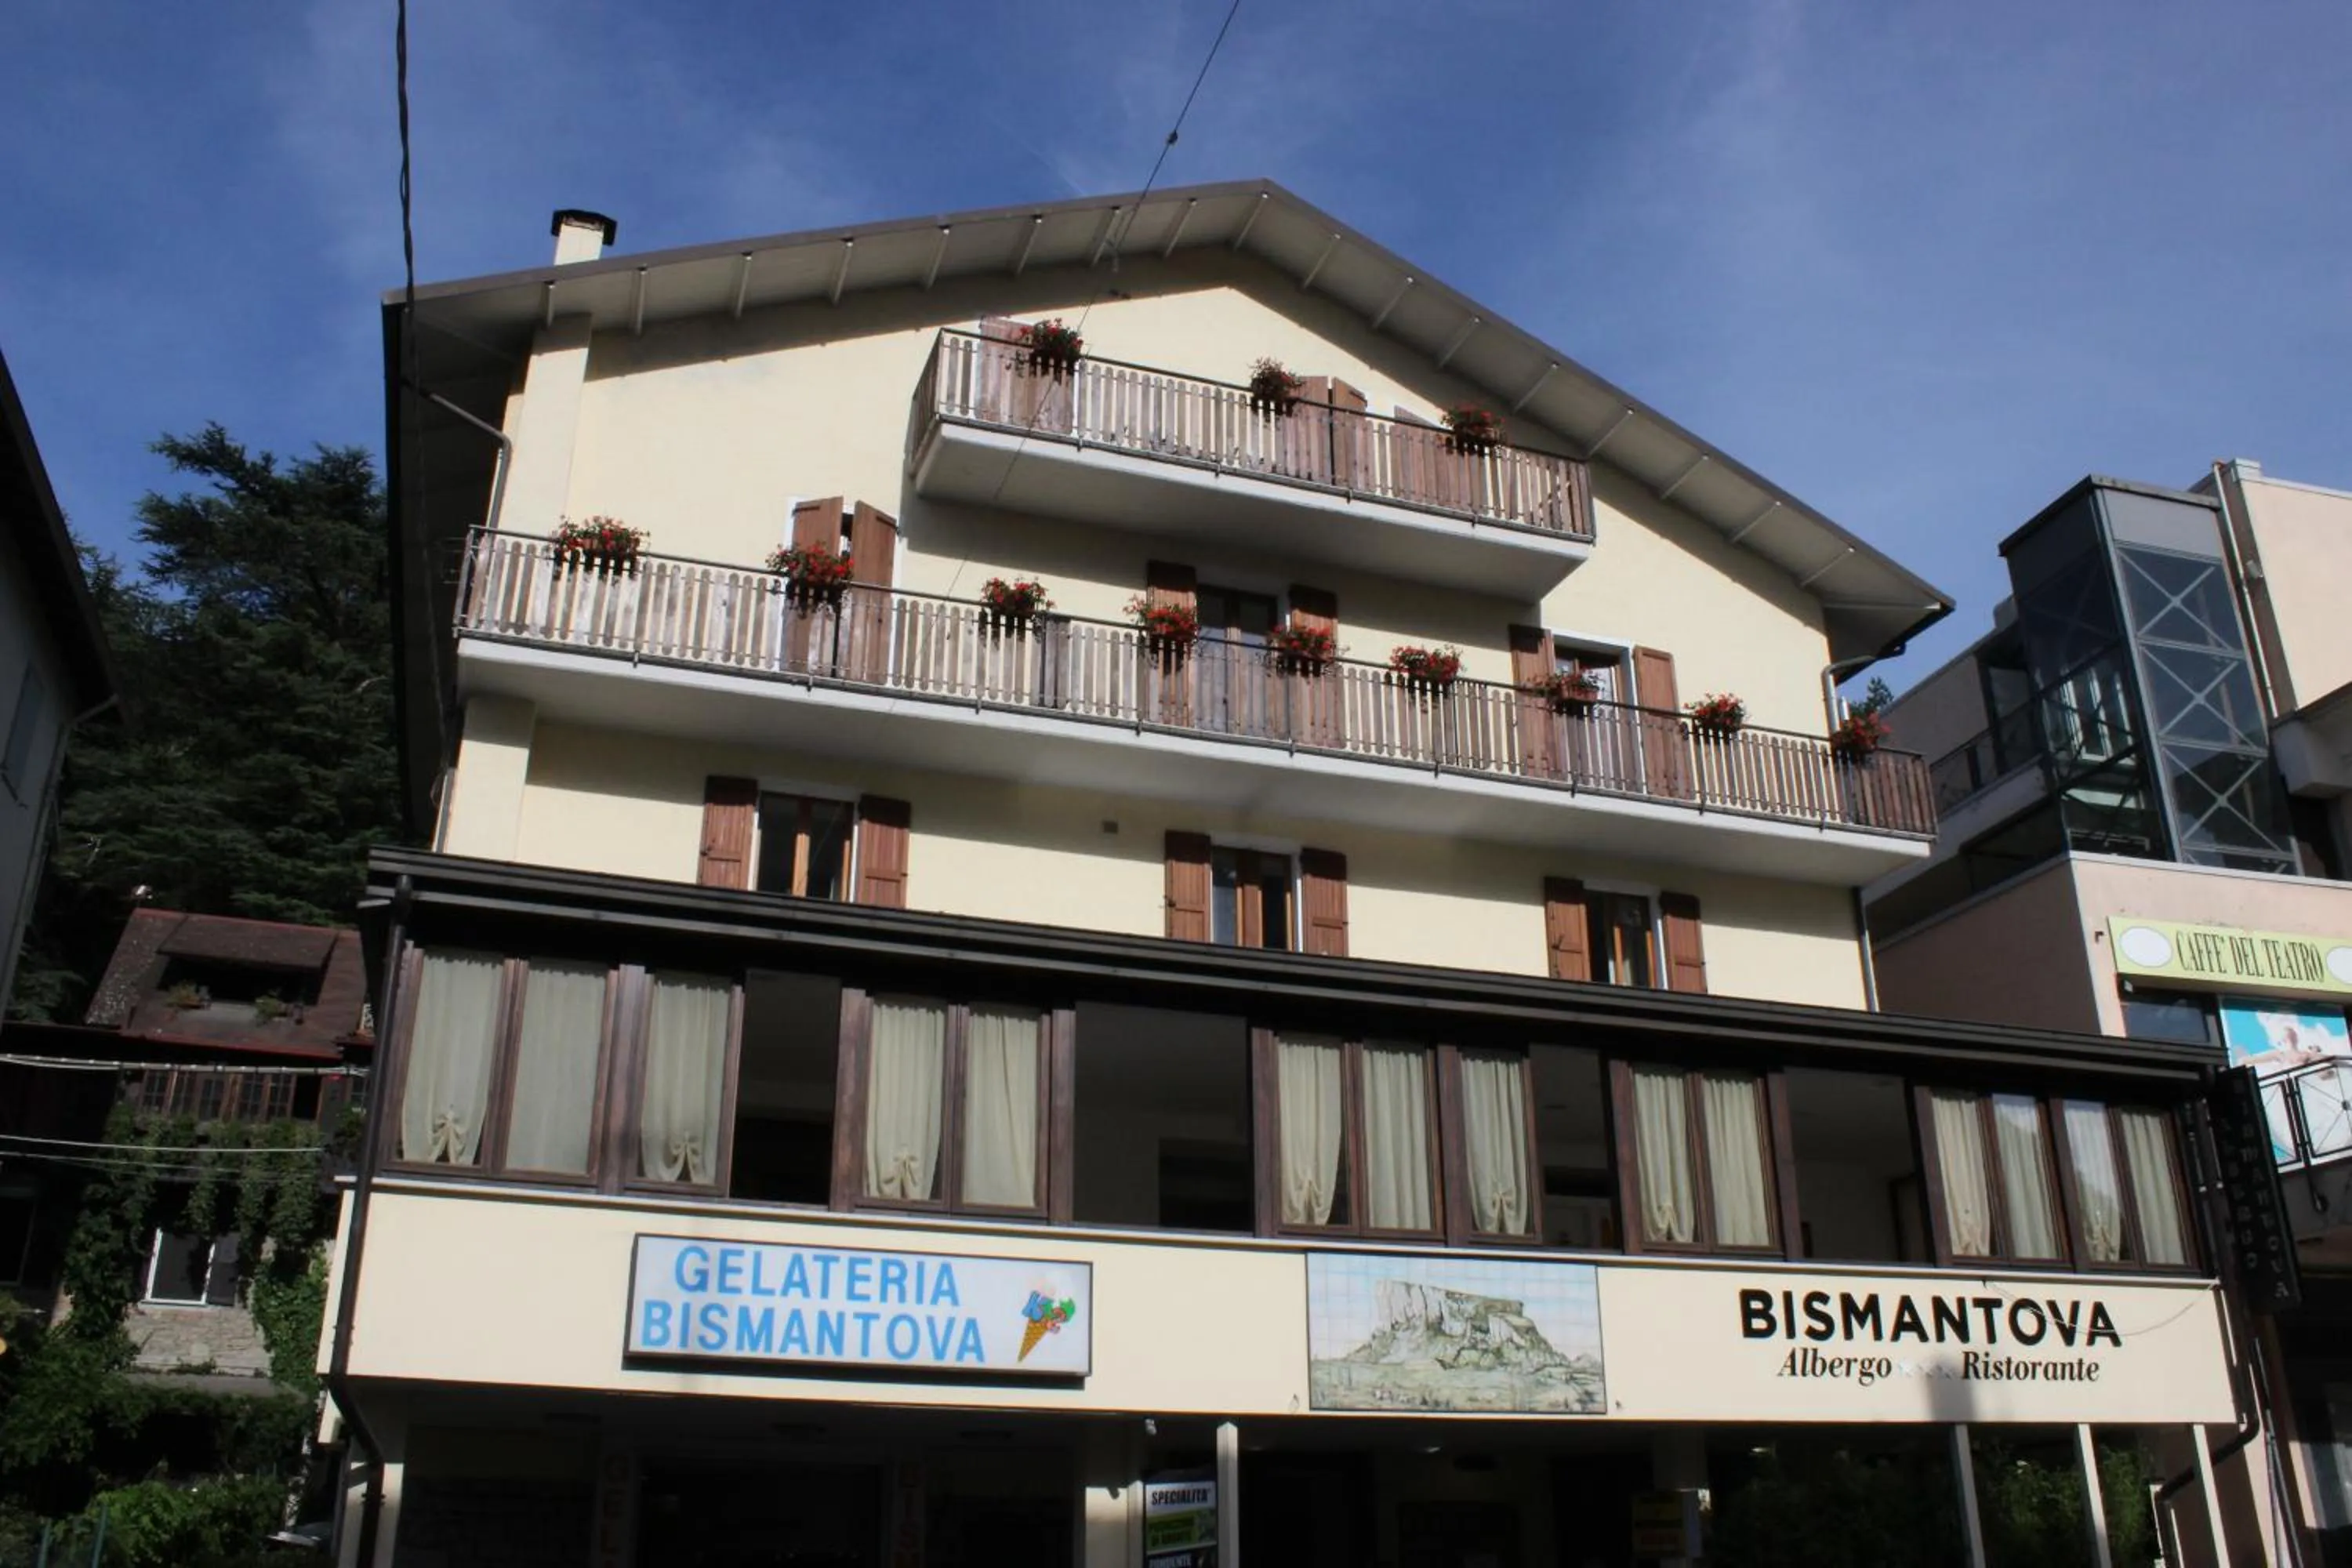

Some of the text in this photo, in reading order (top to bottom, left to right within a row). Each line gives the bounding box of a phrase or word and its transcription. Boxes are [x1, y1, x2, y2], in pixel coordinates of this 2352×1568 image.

[2229, 935, 2265, 978] DEL
[2261, 938, 2325, 982] TEATRO
[674, 1245, 960, 1307] GELATERIA
[641, 1299, 986, 1363] BISMANTOVA
[1739, 1288, 2122, 1347] BISMANTOVA
[1777, 1347, 2100, 1386] Albergo Ristorante
